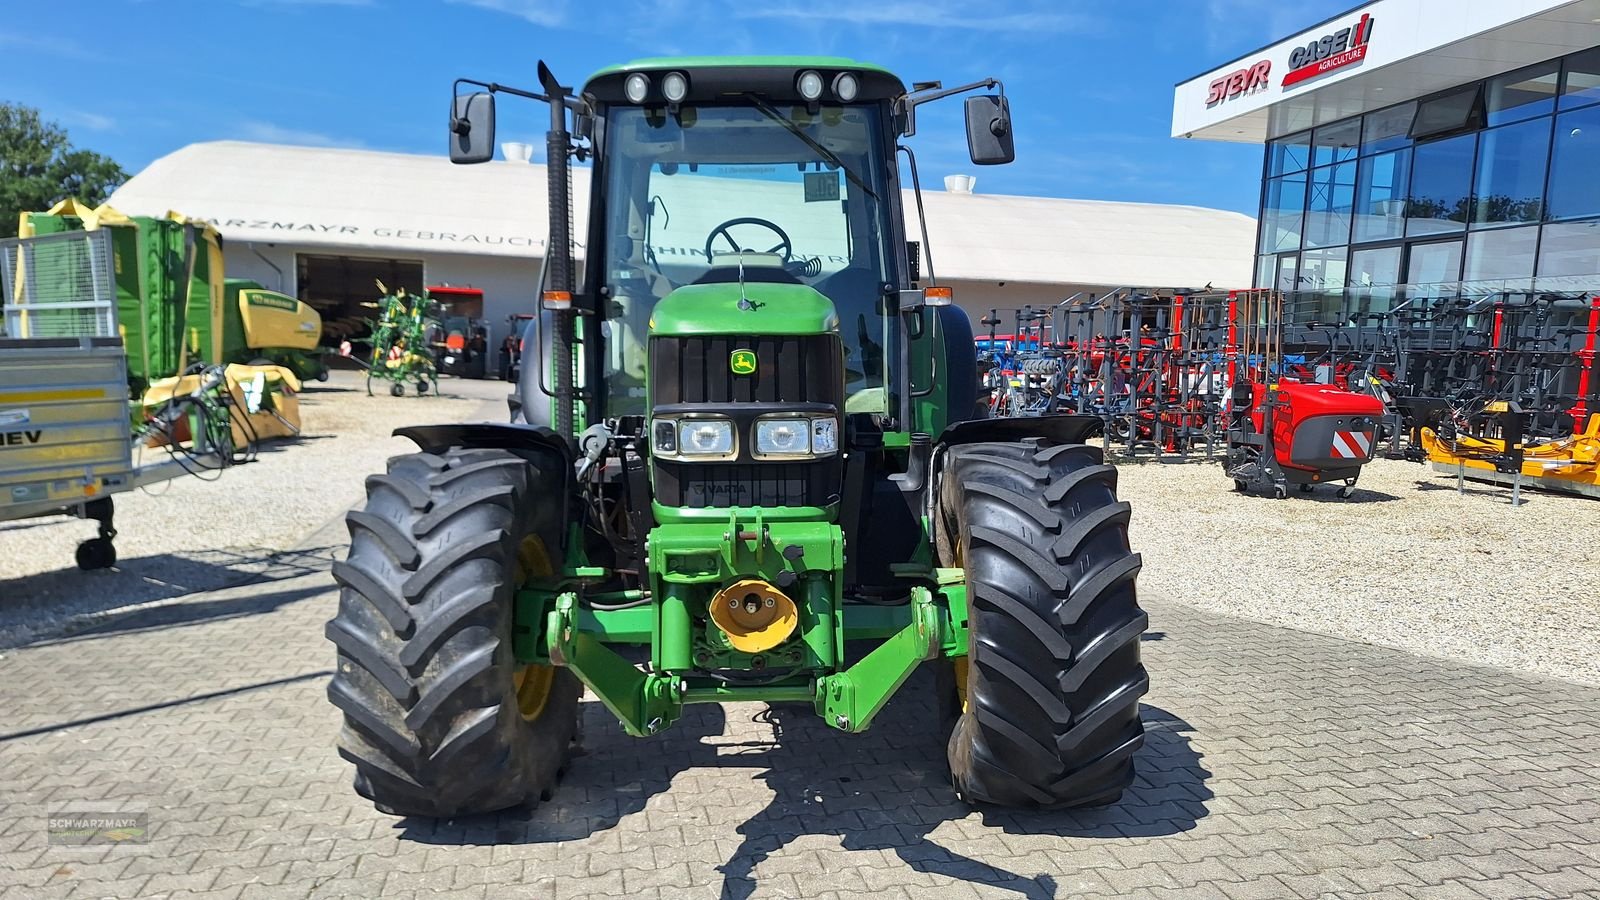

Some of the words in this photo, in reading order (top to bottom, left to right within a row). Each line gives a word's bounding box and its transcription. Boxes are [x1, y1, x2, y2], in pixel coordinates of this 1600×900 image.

[1288, 27, 1351, 70] CASE
[1318, 49, 1362, 71] AGRICULTURE
[1205, 60, 1272, 106] STEYR
[206, 217, 360, 235] ARZMAYR
[373, 227, 545, 247] GEBRAUCH
[707, 484, 747, 494] VARTA
